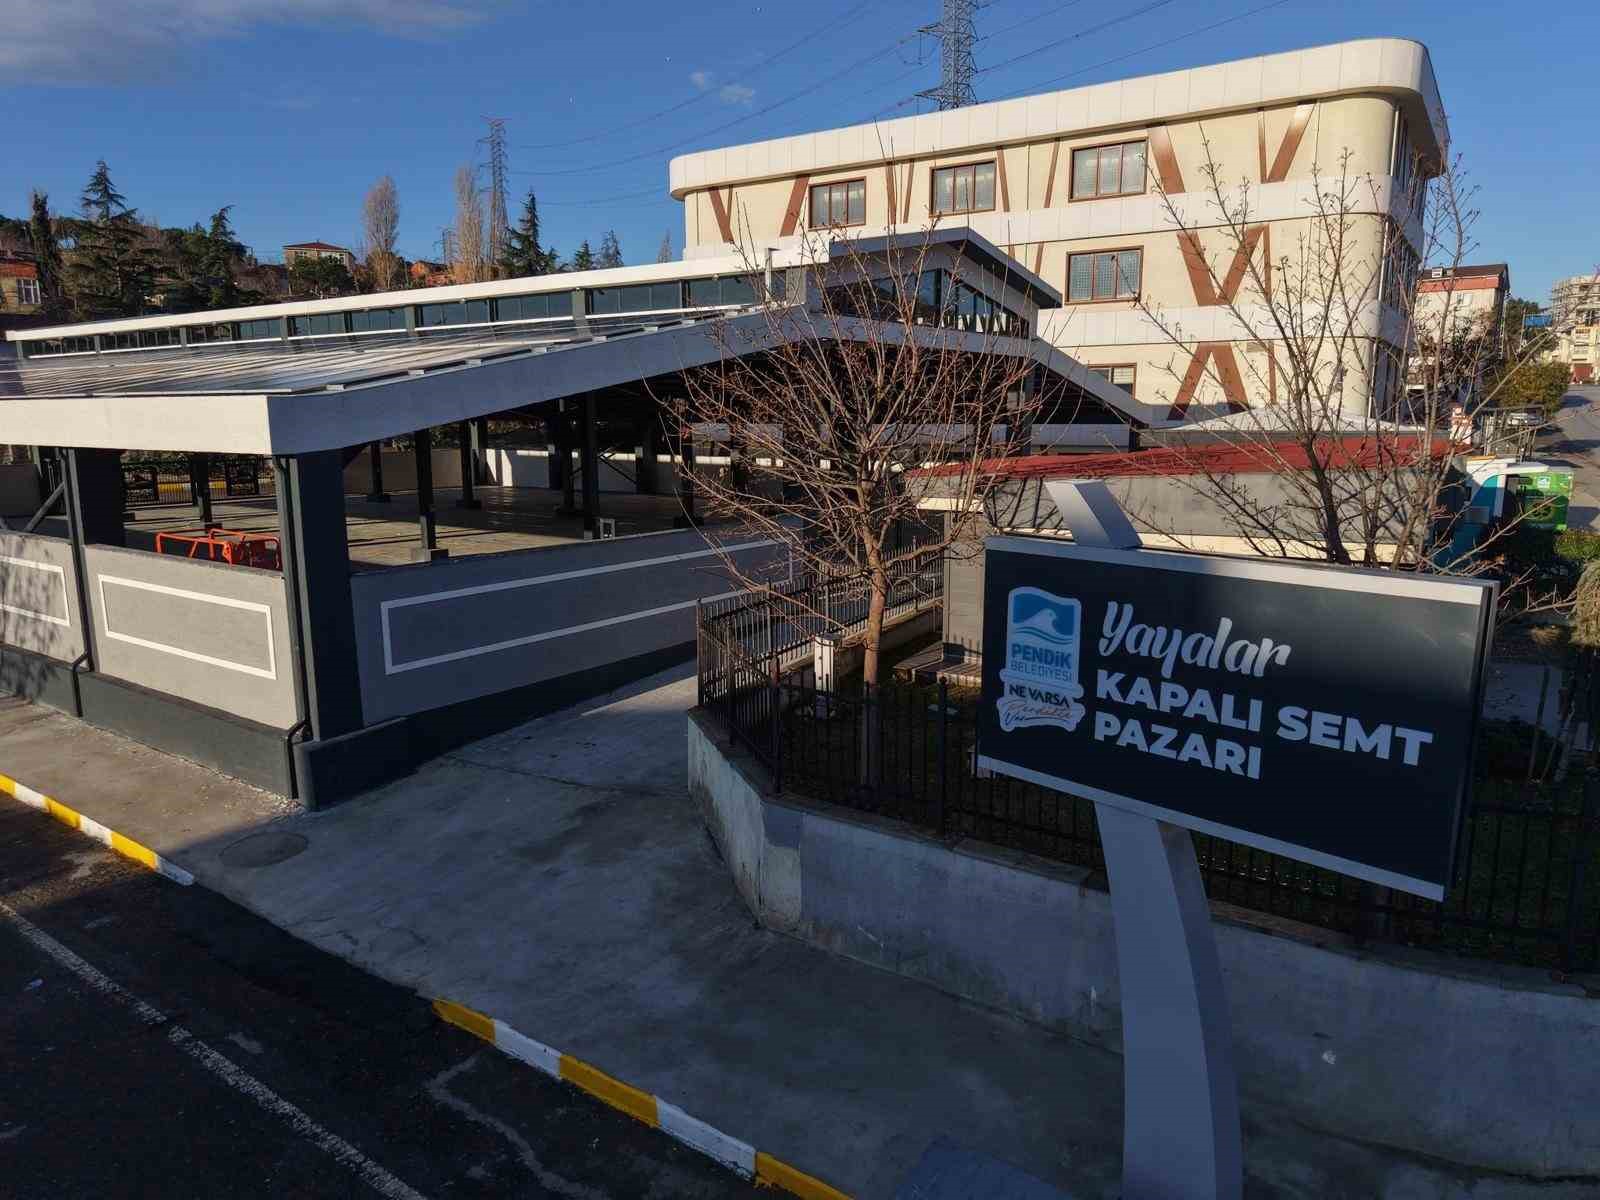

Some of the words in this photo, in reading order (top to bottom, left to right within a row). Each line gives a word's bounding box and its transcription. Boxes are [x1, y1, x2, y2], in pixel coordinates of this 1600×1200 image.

[1099, 601, 1292, 678] Yayalar
[1009, 684, 1026, 697] NE
[1028, 687, 1069, 708] VARSA
[1096, 670, 1262, 731] KAPALI
[1277, 706, 1434, 766] SEMT
[1094, 711, 1262, 779] PAZARI
